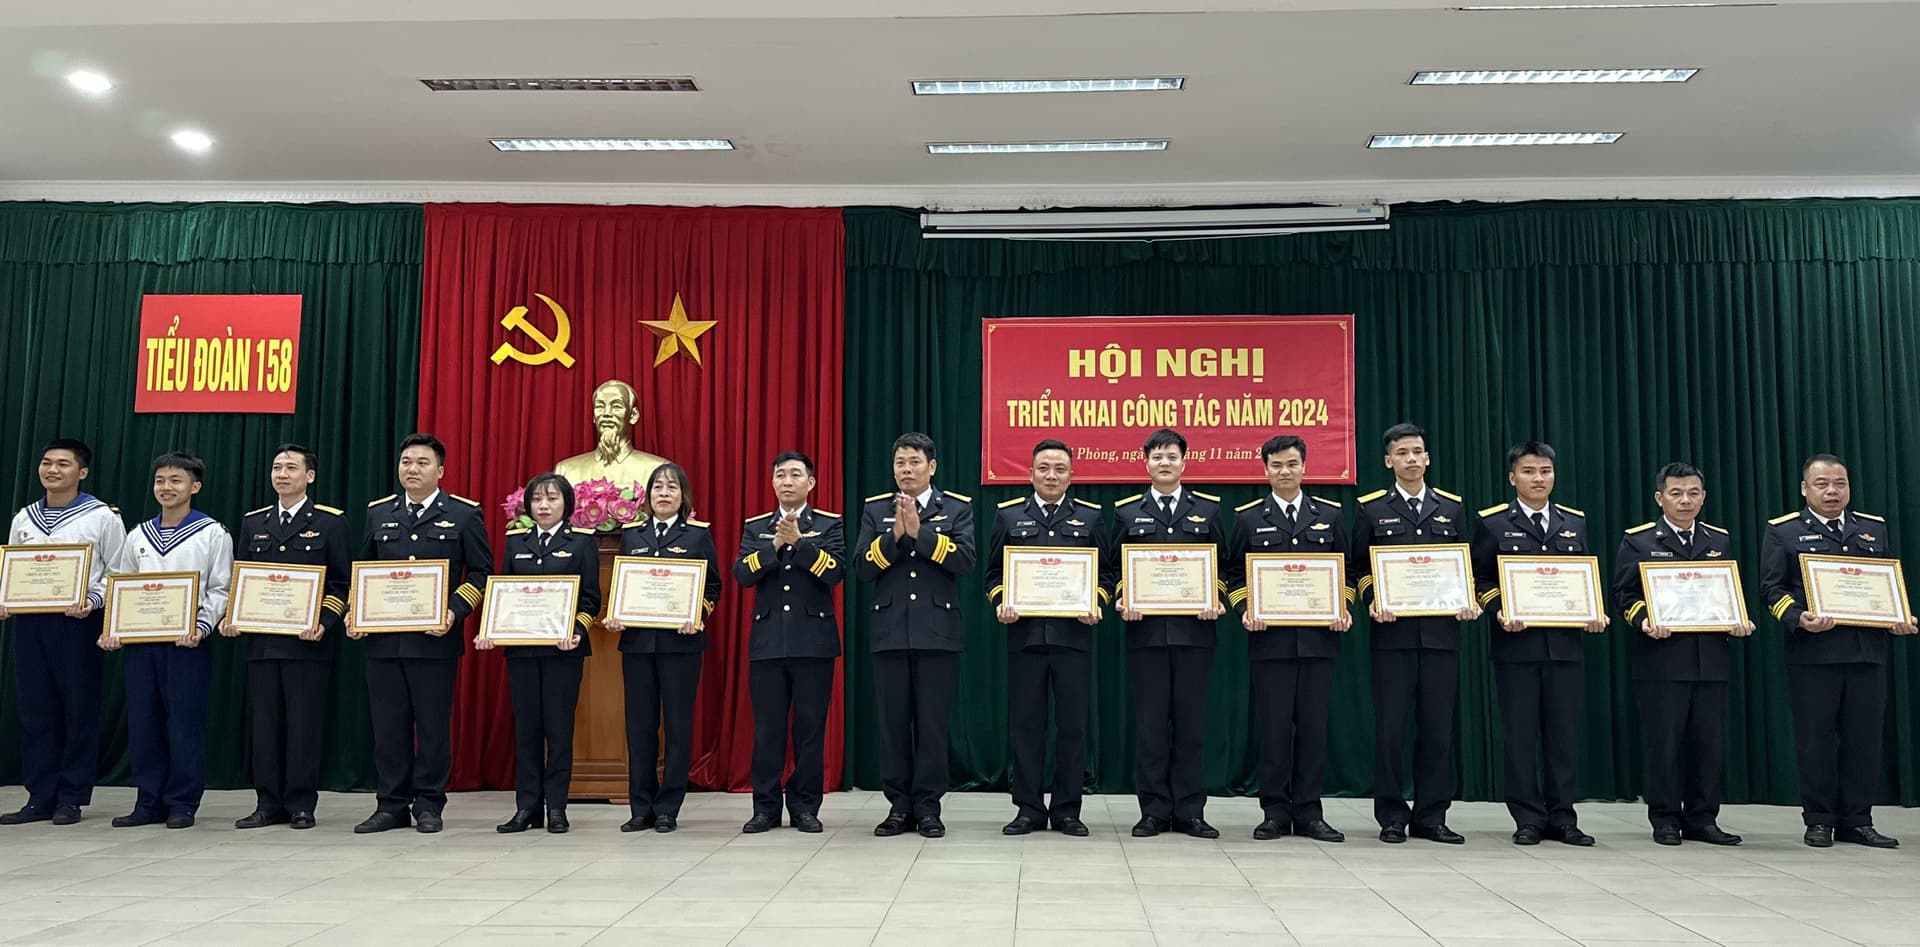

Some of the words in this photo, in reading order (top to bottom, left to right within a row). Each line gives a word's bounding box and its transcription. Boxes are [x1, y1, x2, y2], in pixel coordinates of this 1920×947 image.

[146, 315, 190, 392] TIỂU
[193, 326, 251, 392] ĐOÀN
[257, 338, 293, 392] 158
[1069, 343, 1142, 384] HỘI
[1156, 347, 1264, 383] NGHỊ
[1007, 388, 1064, 427] TRIỂN
[1070, 399, 1117, 427] KHAI
[1122, 393, 1177, 427] CÔNG
[1182, 392, 1220, 427] TÁC
[1226, 392, 1273, 426] NĂM
[1278, 398, 1328, 426] 2024
[1076, 447, 1119, 463] Phòng,
[1122, 447, 1144, 463] ngà
[1183, 447, 1207, 463] áng
[1209, 447, 1222, 460] 11
[1225, 447, 1252, 460] năm
